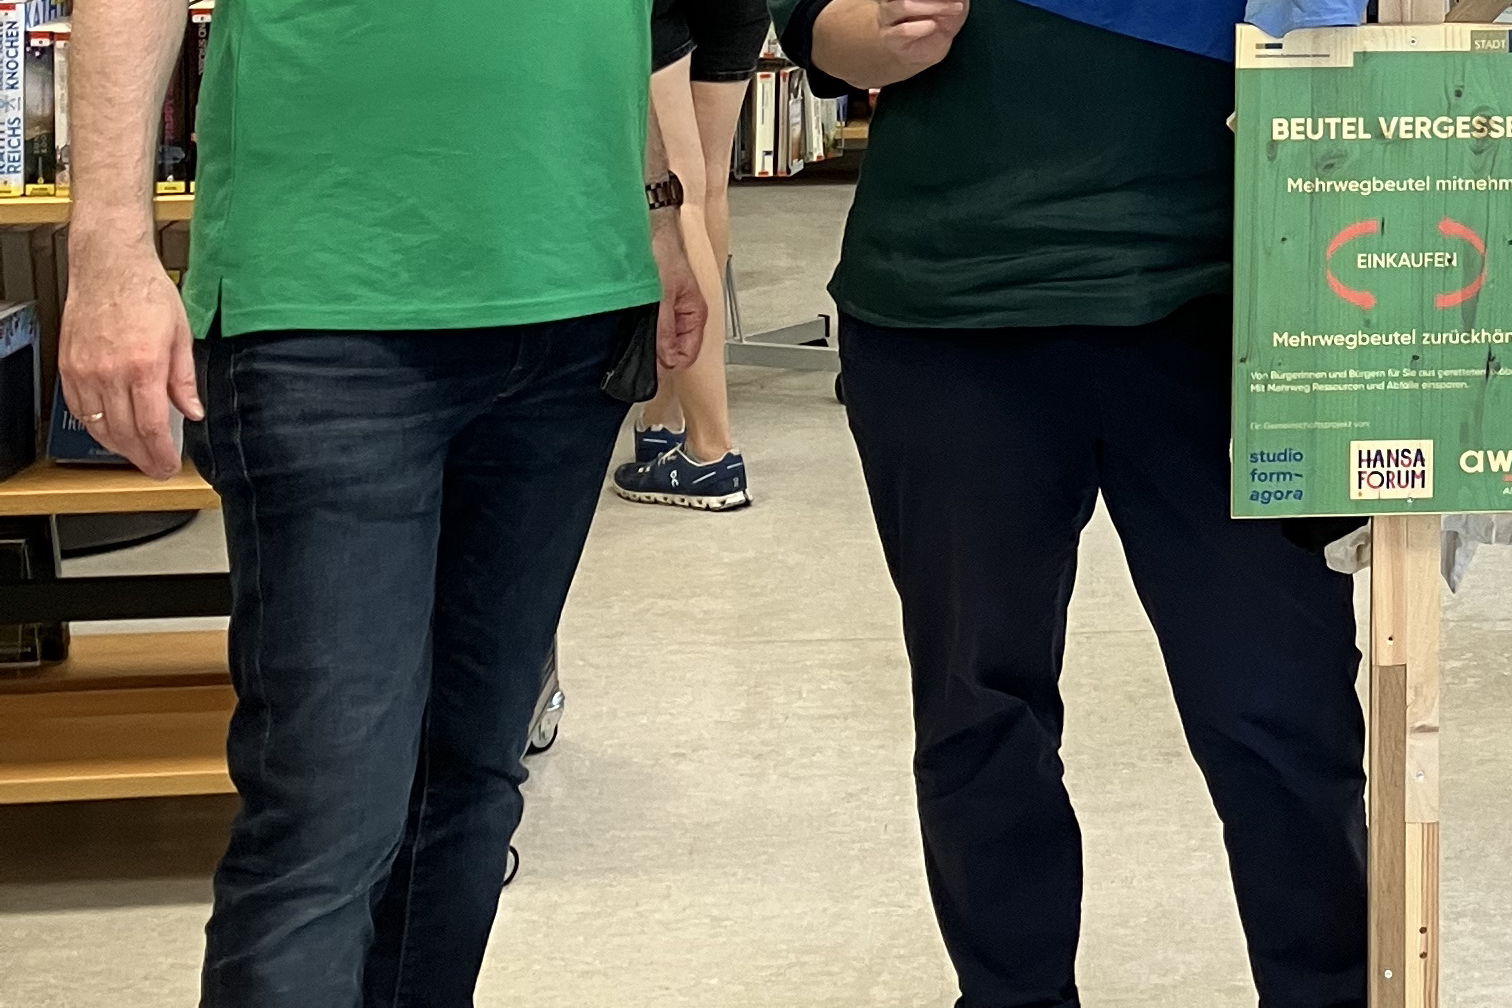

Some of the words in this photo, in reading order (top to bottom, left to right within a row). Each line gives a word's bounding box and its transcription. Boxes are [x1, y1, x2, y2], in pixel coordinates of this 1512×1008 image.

[1474, 39, 1505, 49] STADT
[4, 20, 19, 90] KNOCHEN
[1271, 116, 1371, 141] BEUTEL
[6, 117, 22, 175] REICHS
[1287, 176, 1430, 197] Mehrwegbeutel
[1357, 251, 1458, 269] EINKAUFEN
[1272, 329, 1416, 350] Mehrwegbeutel
[1251, 371, 1269, 380] Von
[1328, 370, 1347, 379] und
[1349, 369, 1385, 380] Bürgern
[1387, 368, 1400, 378] für
[1402, 368, 1417, 377] Sie
[1419, 369, 1436, 377] aus
[1251, 383, 1265, 392] Mit
[1267, 382, 1310, 393] Mehrweg
[1312, 381, 1365, 391] Ressourcen
[1366, 381, 1385, 391] und
[1250, 447, 1304, 463] studio
[1358, 448, 1426, 469] HANSA
[1358, 469, 1426, 490] FORUM
[1250, 487, 1304, 504] agora
